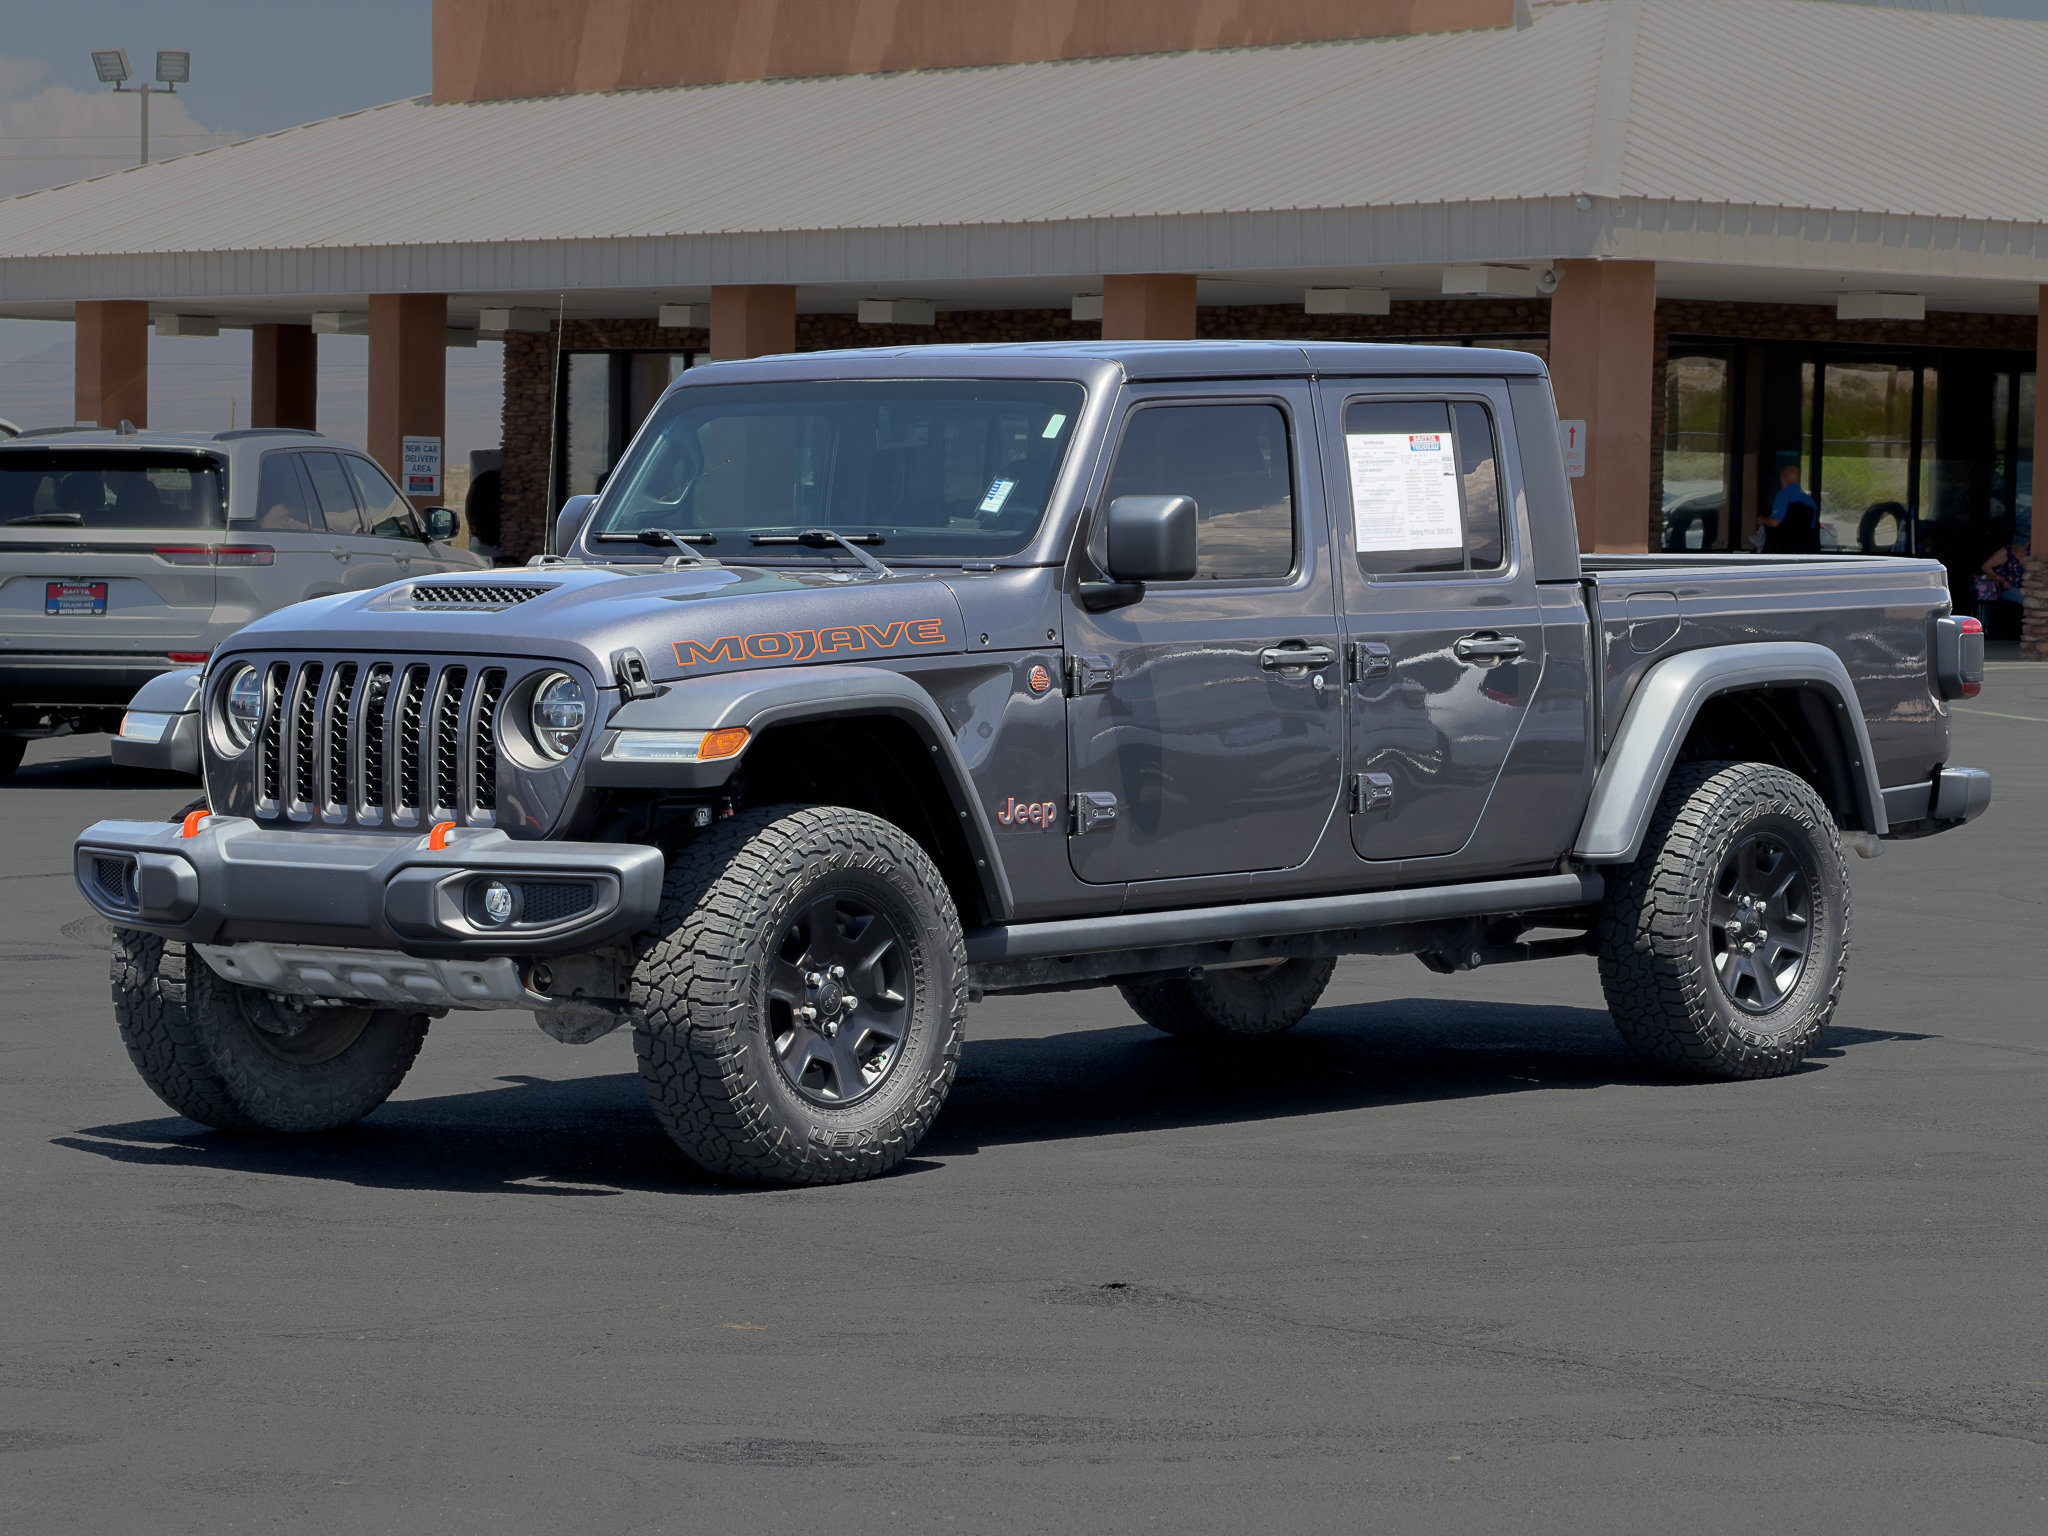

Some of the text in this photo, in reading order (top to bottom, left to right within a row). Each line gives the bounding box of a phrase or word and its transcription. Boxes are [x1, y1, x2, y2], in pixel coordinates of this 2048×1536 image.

[405, 444, 438, 453] NEW CAR
[1411, 442, 1439, 450] TRUDEAU
[405, 454, 438, 463] DELIVERY
[412, 464, 431, 472] AREA
[672, 619, 946, 666] MOJAVE
[998, 798, 1057, 828] Jeep
